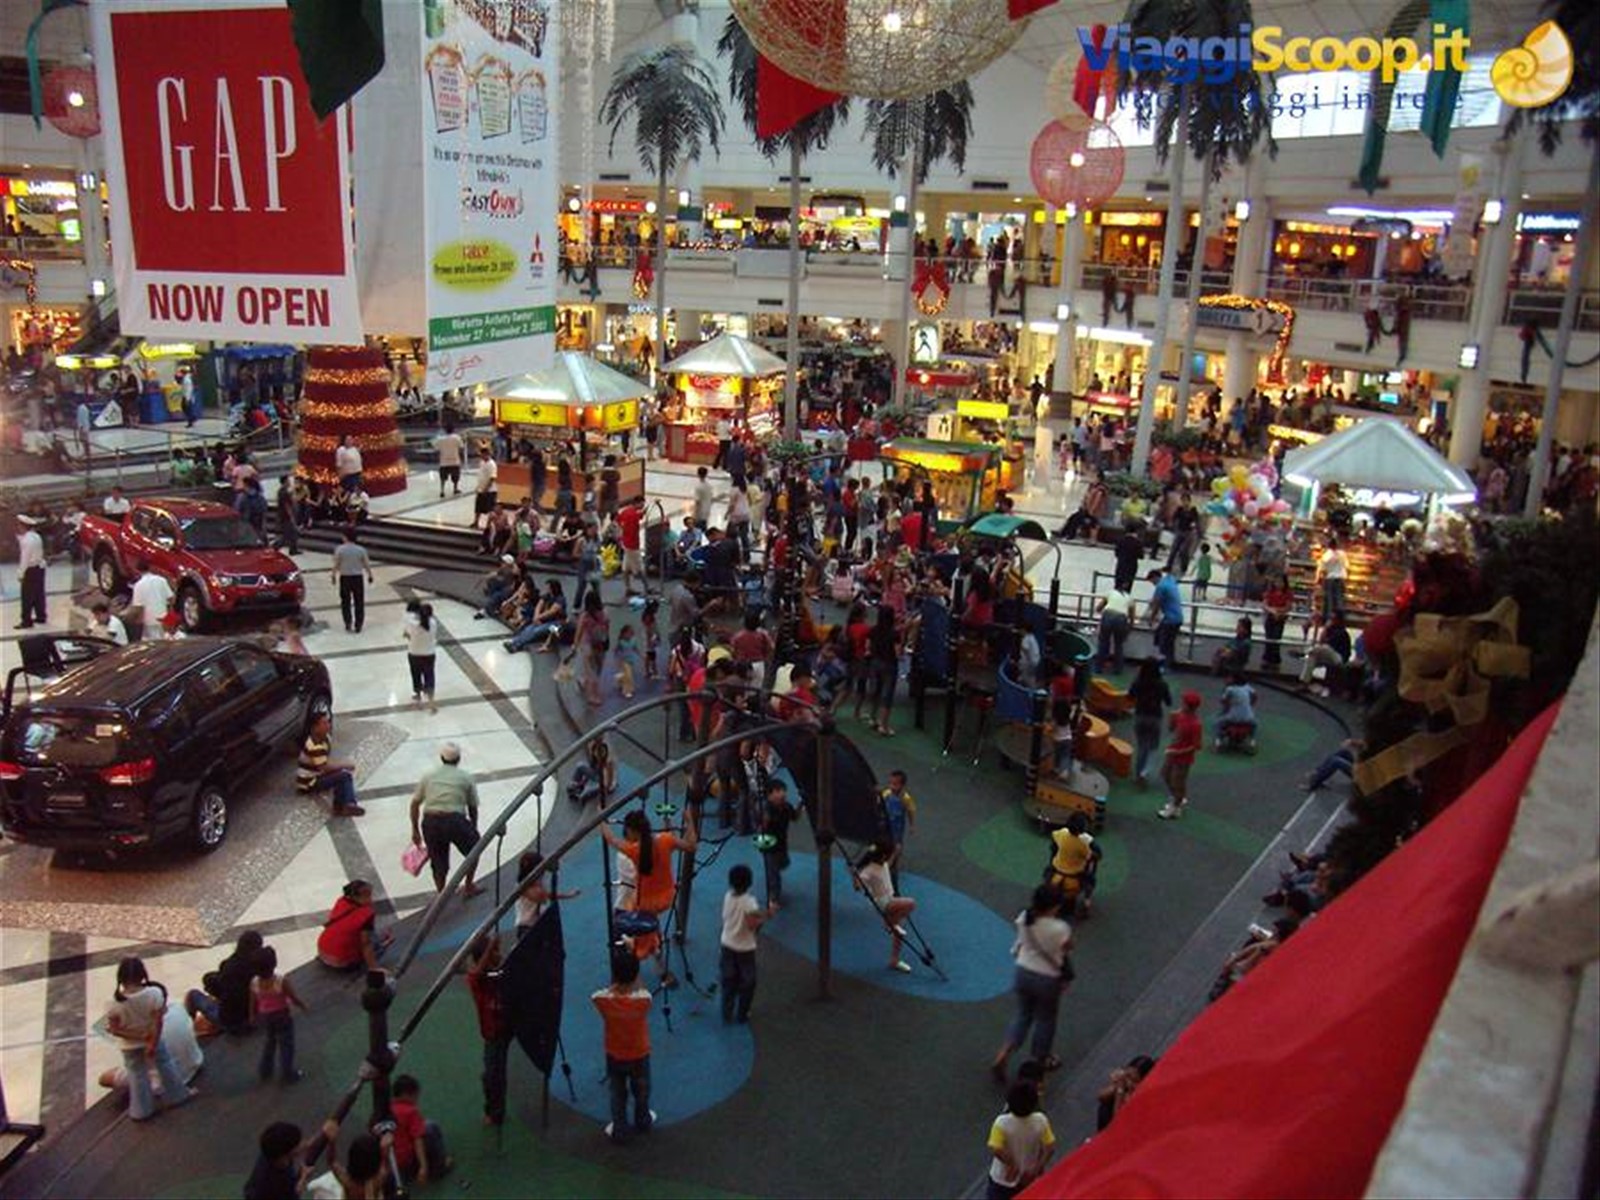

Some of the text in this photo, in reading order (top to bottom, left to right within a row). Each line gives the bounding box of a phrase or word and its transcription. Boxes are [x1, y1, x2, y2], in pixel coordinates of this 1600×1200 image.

[157, 75, 298, 213] GAP
[147, 282, 331, 328] NOW OPEN
